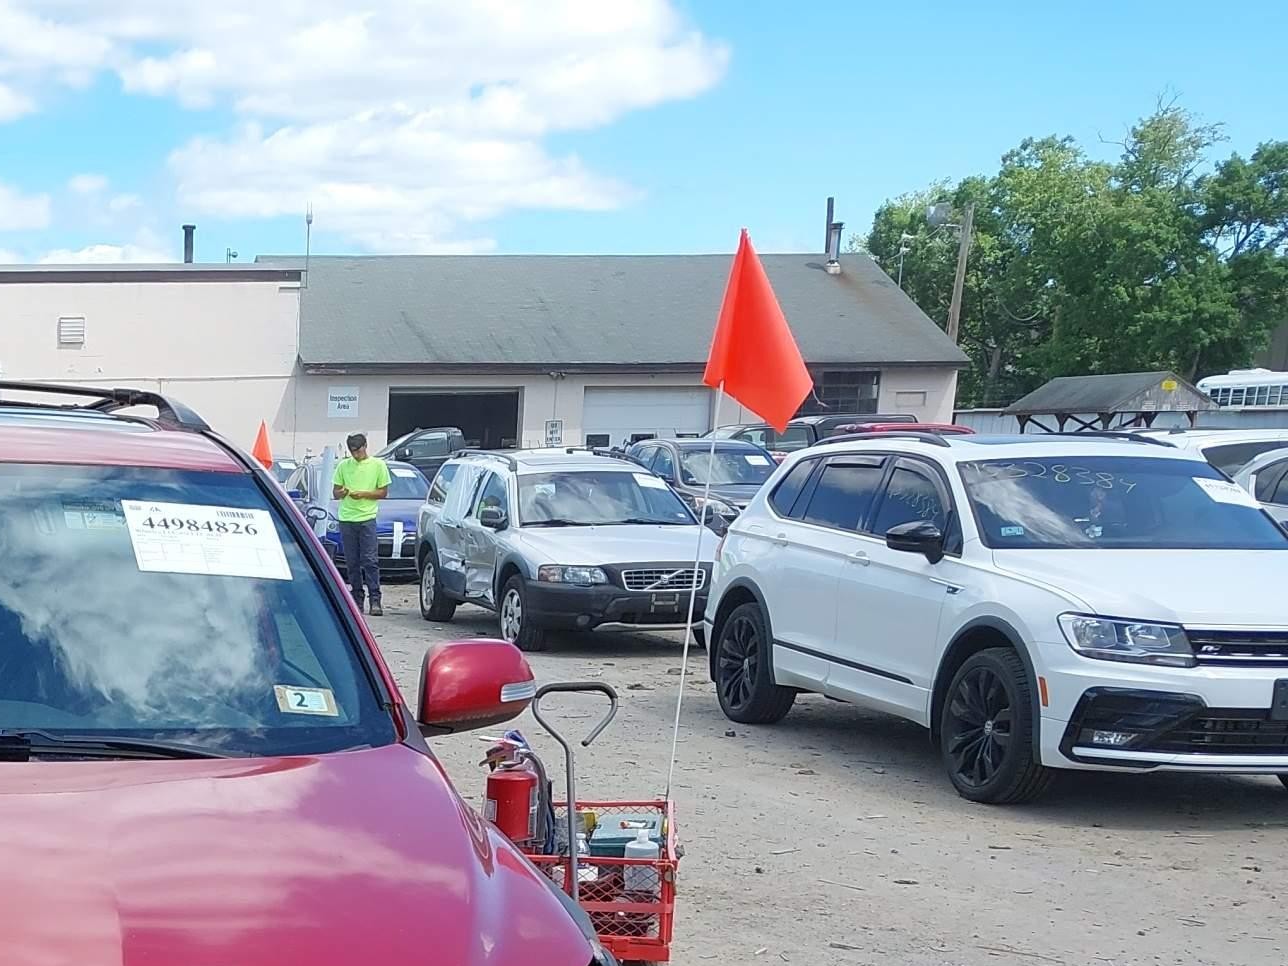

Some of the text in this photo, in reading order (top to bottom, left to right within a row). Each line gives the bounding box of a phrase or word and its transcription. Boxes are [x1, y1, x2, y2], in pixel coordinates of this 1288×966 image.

[329, 394, 358, 402] Inspection
[336, 402, 350, 410] Area
[141, 516, 259, 536] 44984826
[293, 692, 309, 708] 2
